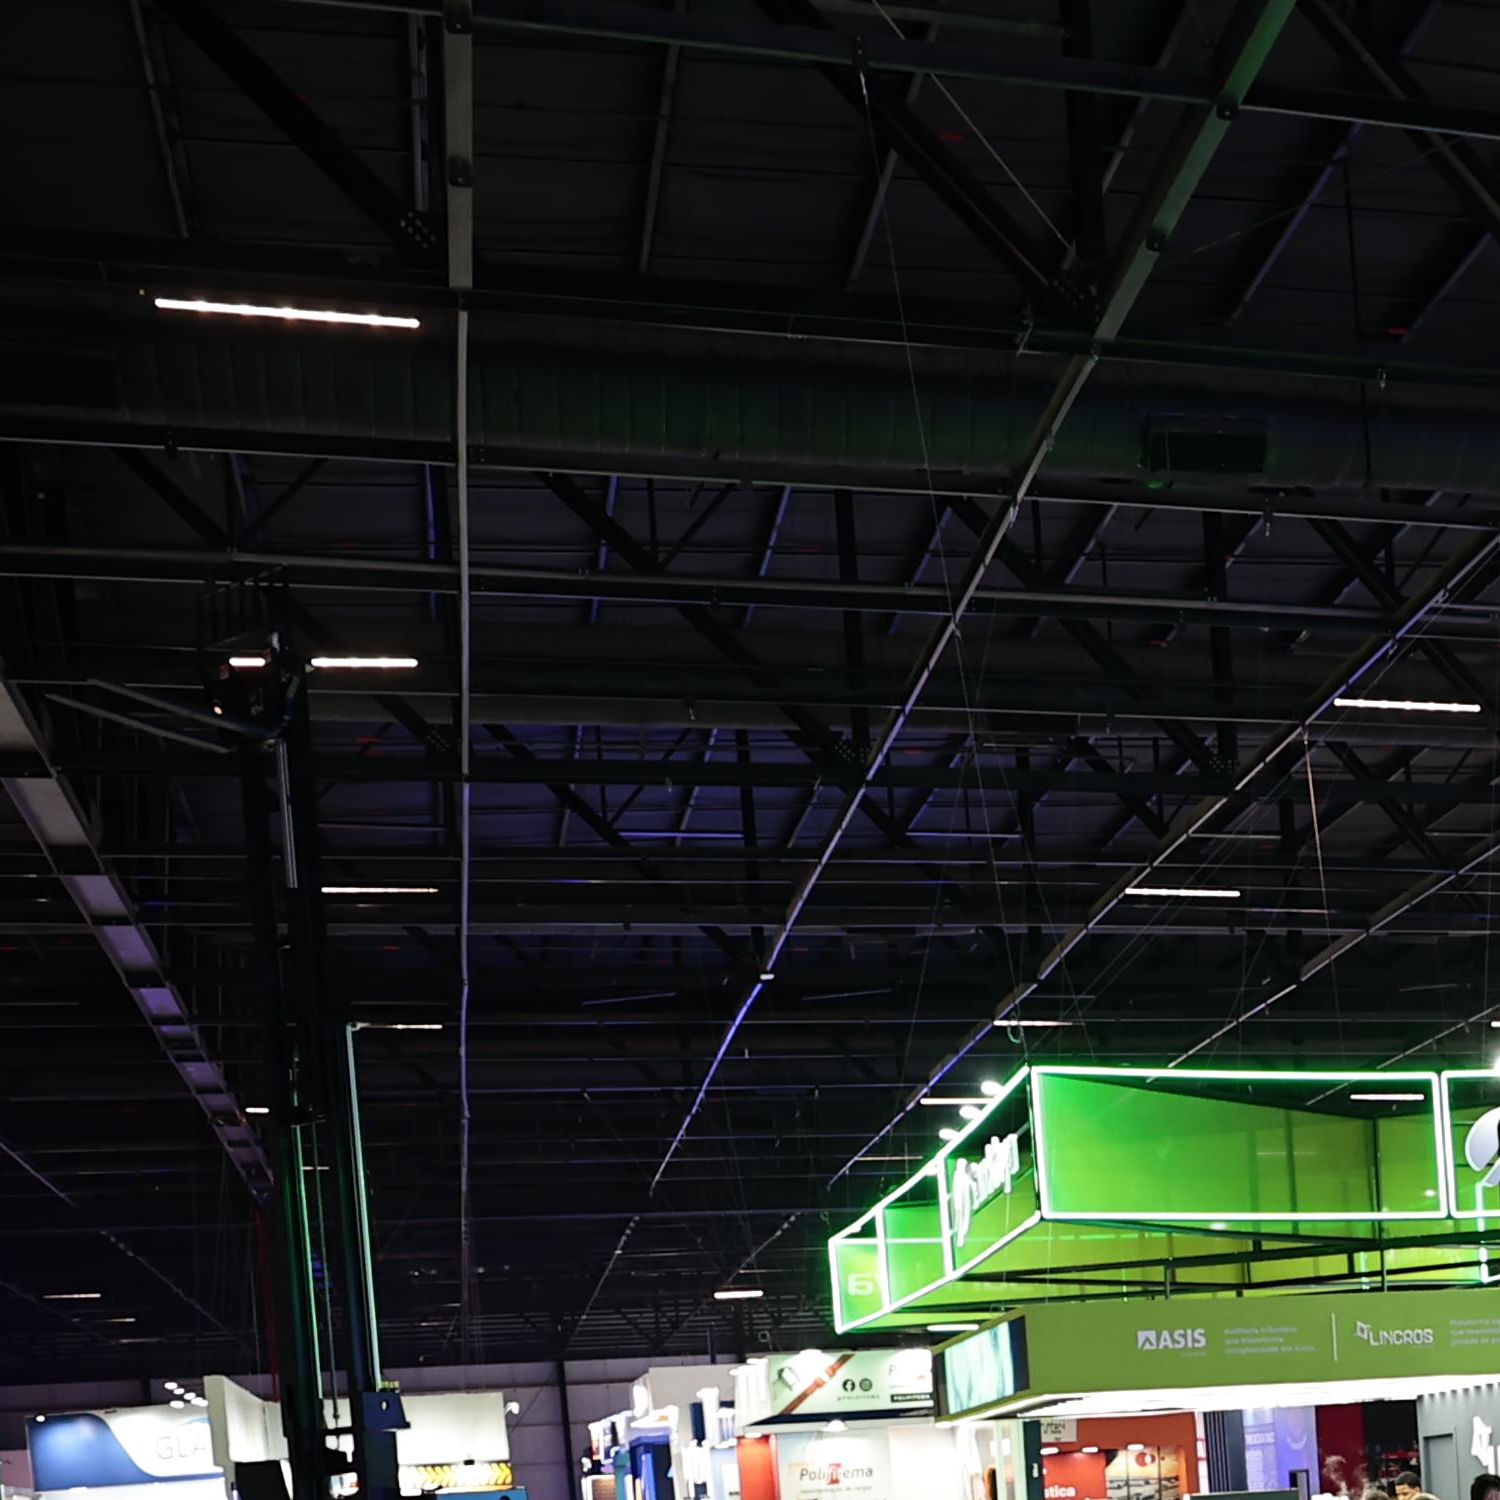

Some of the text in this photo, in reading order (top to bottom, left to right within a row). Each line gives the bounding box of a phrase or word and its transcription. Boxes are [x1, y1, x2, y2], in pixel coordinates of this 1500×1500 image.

[1158, 1328, 1207, 1350] ASIS
[1369, 1328, 1434, 1346] LINCROS
[155, 1435, 208, 1460] GLA
[1043, 1484, 1077, 1499] stica
